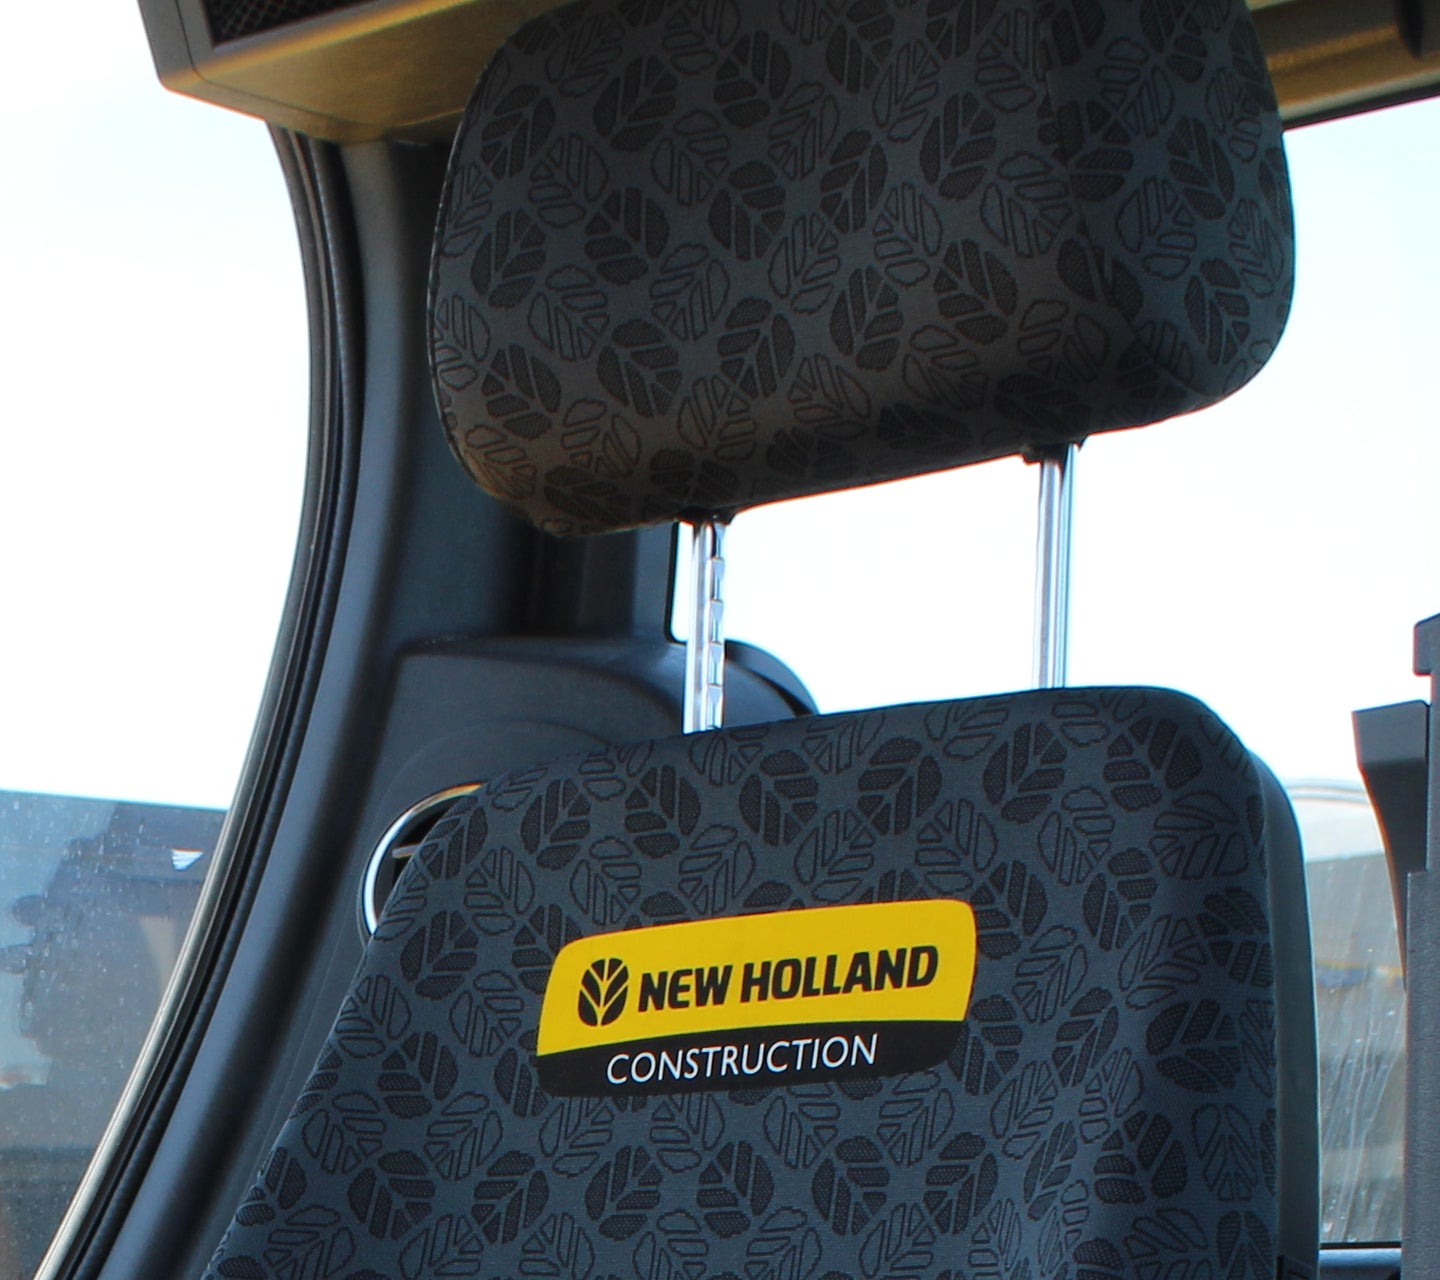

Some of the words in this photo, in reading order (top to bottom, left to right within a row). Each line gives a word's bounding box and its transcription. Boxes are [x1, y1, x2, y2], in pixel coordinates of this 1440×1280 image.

[637, 964, 733, 1013] NEW
[741, 944, 940, 1005] HOLLAND
[604, 1032, 880, 1086] CONSTRUCTION
